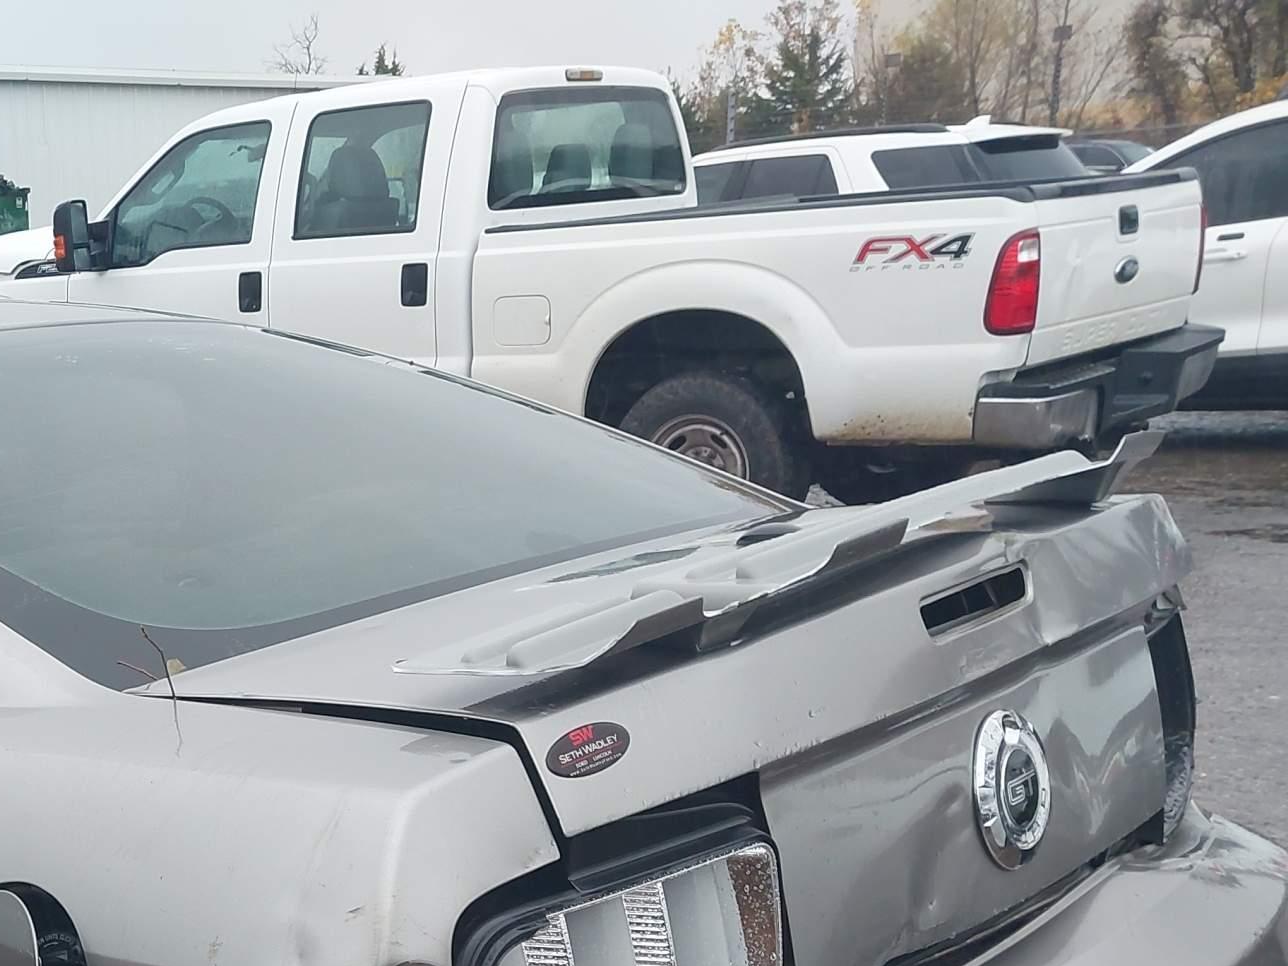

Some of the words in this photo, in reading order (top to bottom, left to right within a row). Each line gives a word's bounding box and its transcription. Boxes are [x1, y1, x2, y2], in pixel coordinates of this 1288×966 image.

[853, 232, 976, 264] FX4
[849, 264, 892, 272] OFF
[902, 263, 964, 271] ROAD
[559, 749, 583, 764] SETH
[582, 734, 617, 754] WADLEY
[568, 726, 593, 746] SW
[1007, 768, 1036, 806] GT
